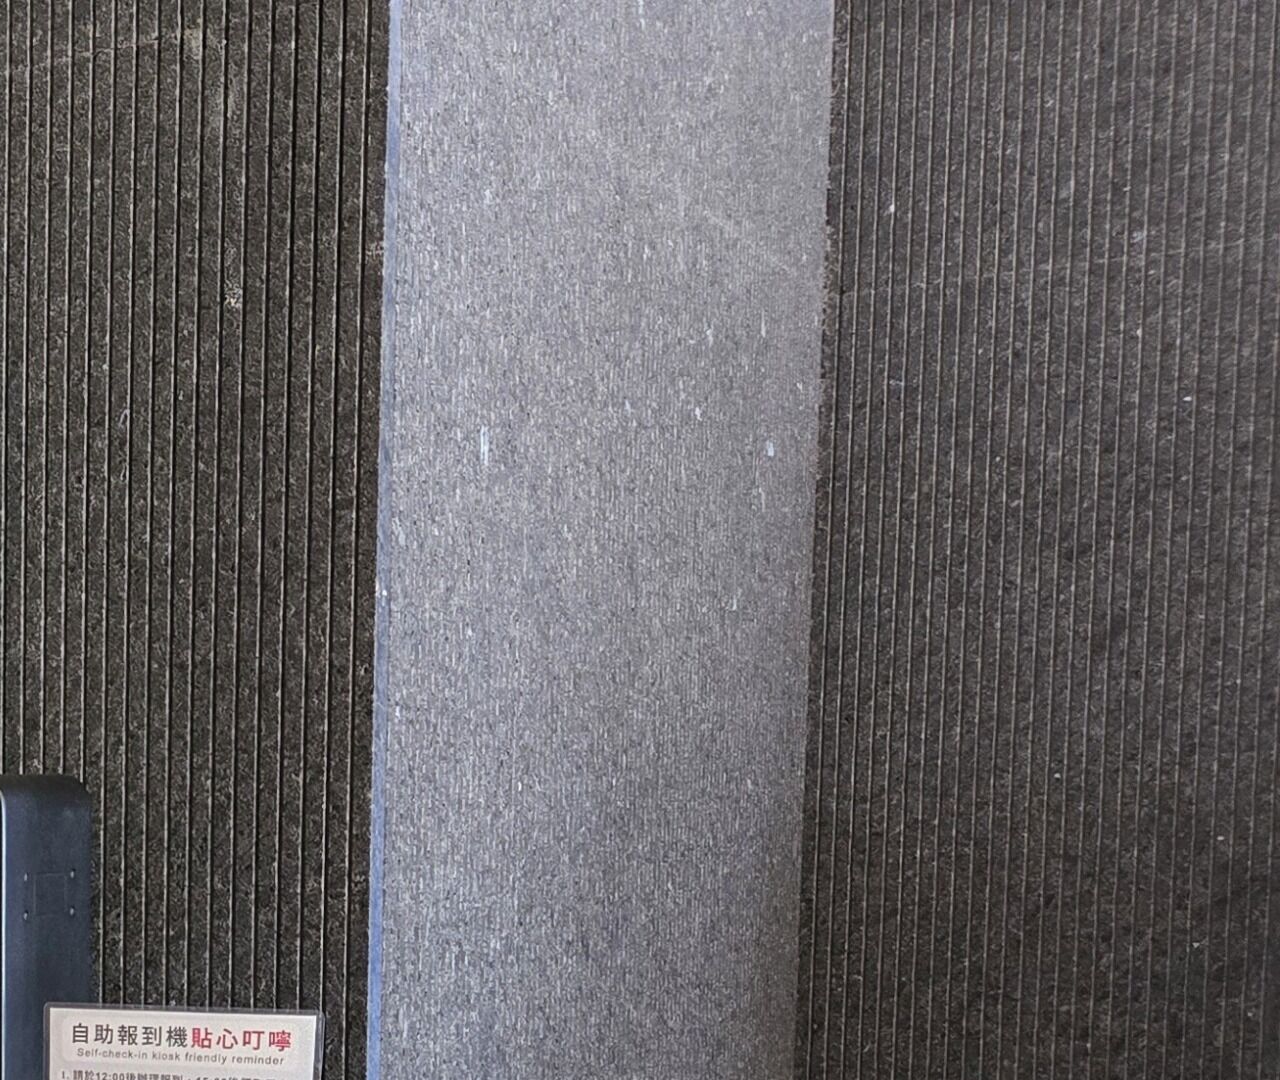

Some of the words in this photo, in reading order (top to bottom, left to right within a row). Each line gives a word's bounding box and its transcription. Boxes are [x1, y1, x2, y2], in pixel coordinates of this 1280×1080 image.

[77, 1048, 148, 1060] Self-check-in
[152, 1051, 180, 1061] kiosk
[185, 1052, 227, 1065] friendly
[232, 1055, 285, 1065] reminder
